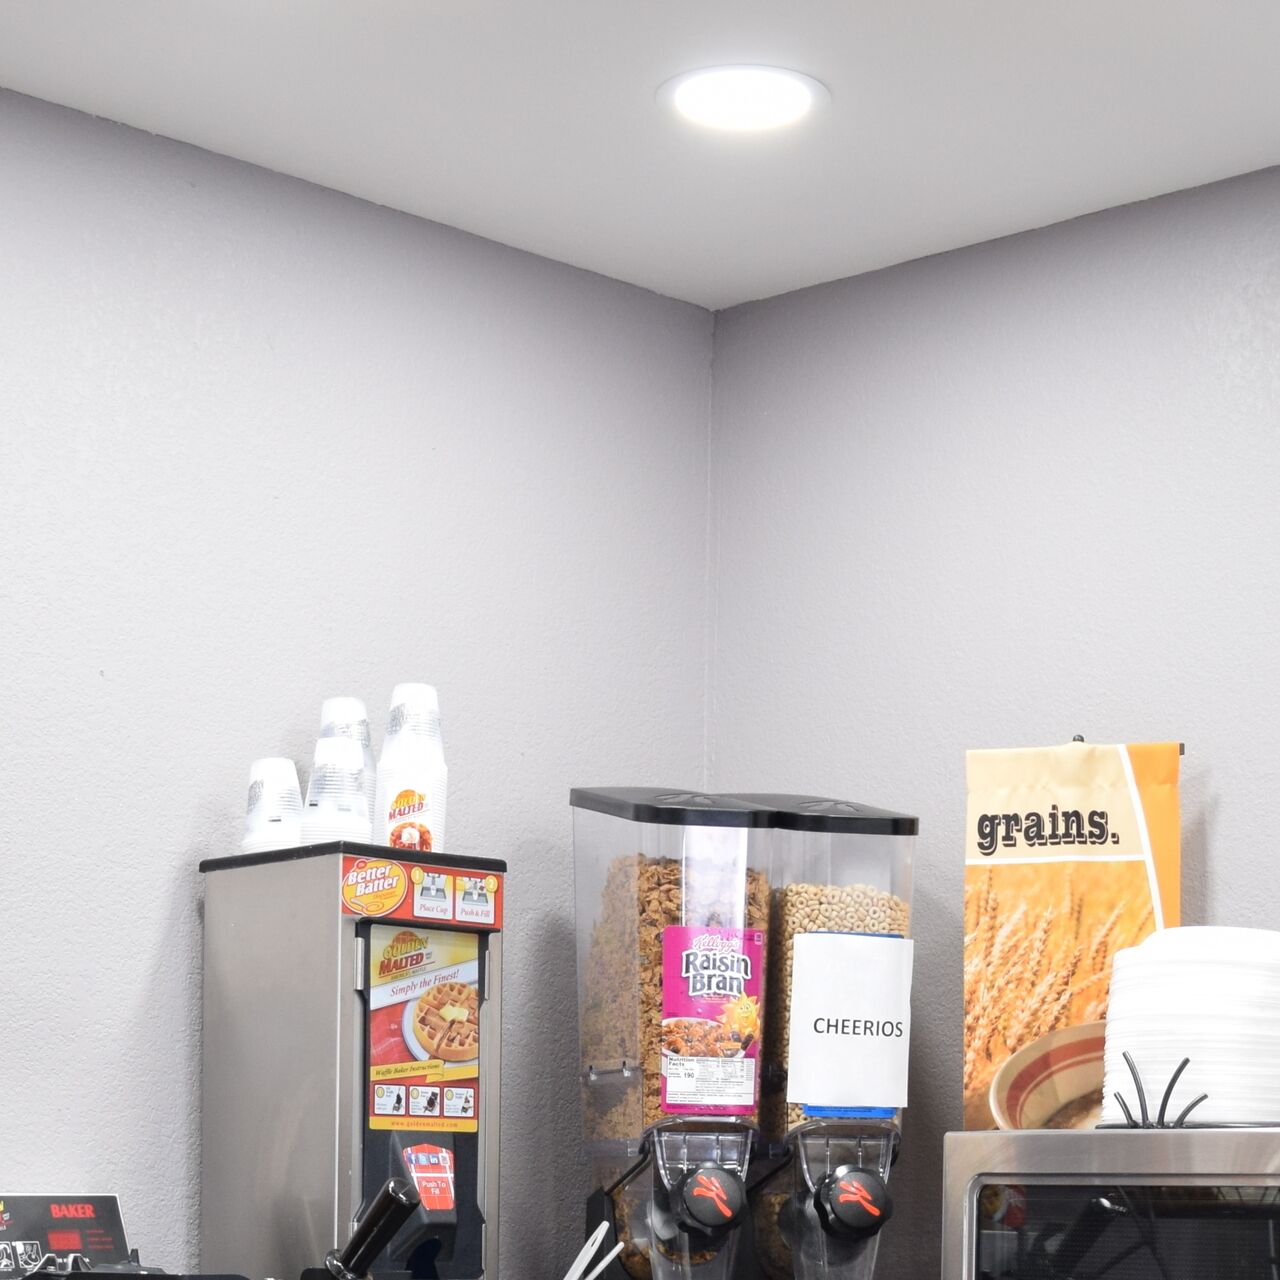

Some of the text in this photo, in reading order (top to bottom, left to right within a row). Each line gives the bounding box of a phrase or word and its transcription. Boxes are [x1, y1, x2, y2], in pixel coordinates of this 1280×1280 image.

[388, 801, 424, 821] MALTED
[977, 804, 1120, 857] grains.
[347, 865, 392, 886] Better
[355, 876, 399, 897] Batter
[419, 903, 449, 915] Place Cup
[383, 936, 429, 960] GOLDEN
[693, 933, 740, 952] Kellogg's
[379, 952, 425, 976] MALTED
[682, 950, 751, 979] Raisin
[390, 968, 460, 997] Simply the Finest!
[690, 972, 743, 995] Bran
[813, 1017, 904, 1038] CHEERIOS
[50, 1203, 97, 1219] BAKER
